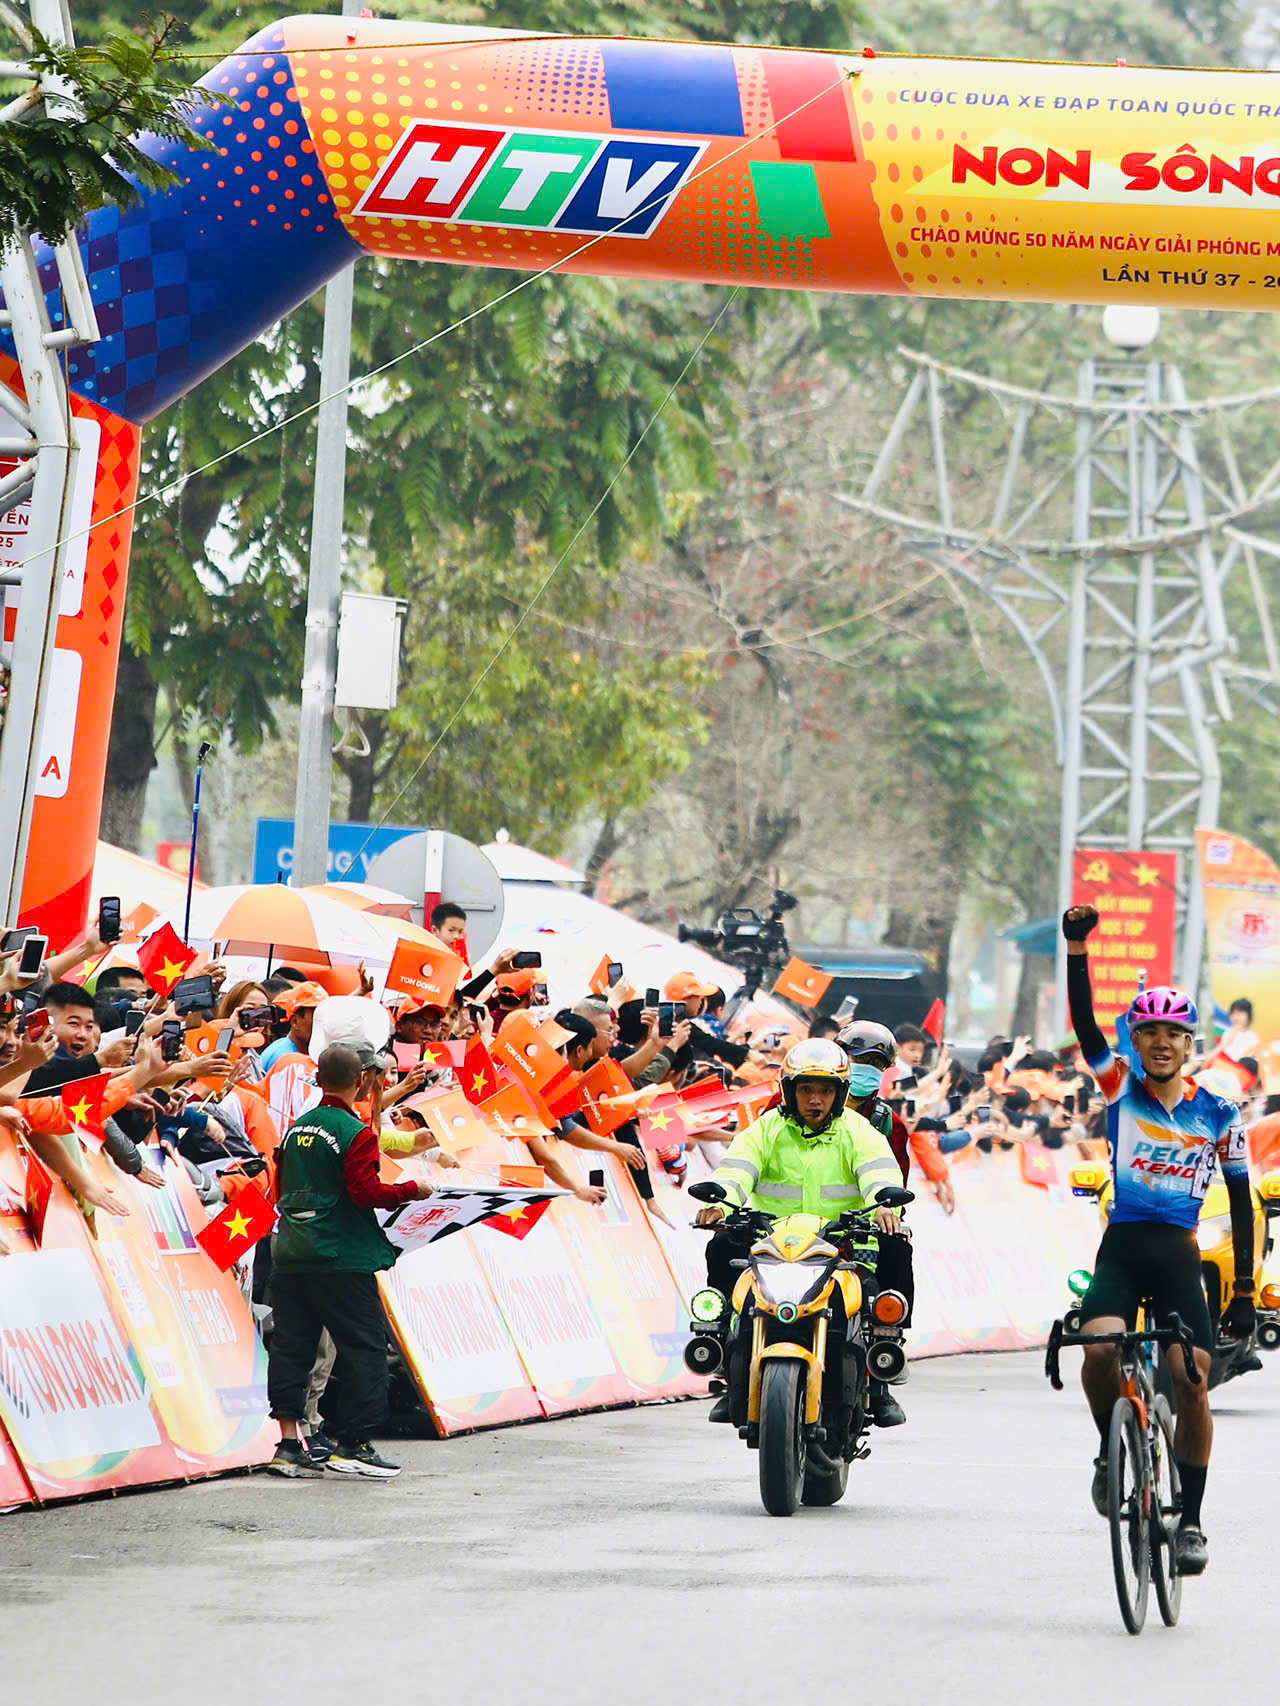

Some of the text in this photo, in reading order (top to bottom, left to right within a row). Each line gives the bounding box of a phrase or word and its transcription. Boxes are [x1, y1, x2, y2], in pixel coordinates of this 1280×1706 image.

[899, 89, 958, 107] CUỘC
[965, 93, 1010, 106] ĐUA
[1018, 95, 1045, 108] XE
[1054, 96, 1100, 113] ĐẠP
[1107, 96, 1169, 113] TOÀN
[1176, 98, 1236, 116] QUỐC
[951, 143, 1091, 190] NON
[380, 142, 680, 220] HTV
[910, 225, 960, 243] CHÀO
[965, 227, 1020, 246] MỪNG
[1025, 233, 1046, 247] 50
[1052, 230, 1095, 249] NĂM
[1100, 233, 1151, 252] NGÀY
[1155, 232, 1192, 254] GIẢI
[1197, 237, 1261, 256] PHÓNG
[1102, 263, 1150, 283] LẦN
[1158, 268, 1208, 286] THỨ
[1214, 273, 1241, 286] 37
[41, 755, 61, 780] A
[400, 976, 416, 987] TON
[504, 1042, 516, 1057] TON
[296, 1135, 315, 1147] VCF
[2, 1328, 76, 1413] TON
[45, 1320, 123, 1409] DONG
